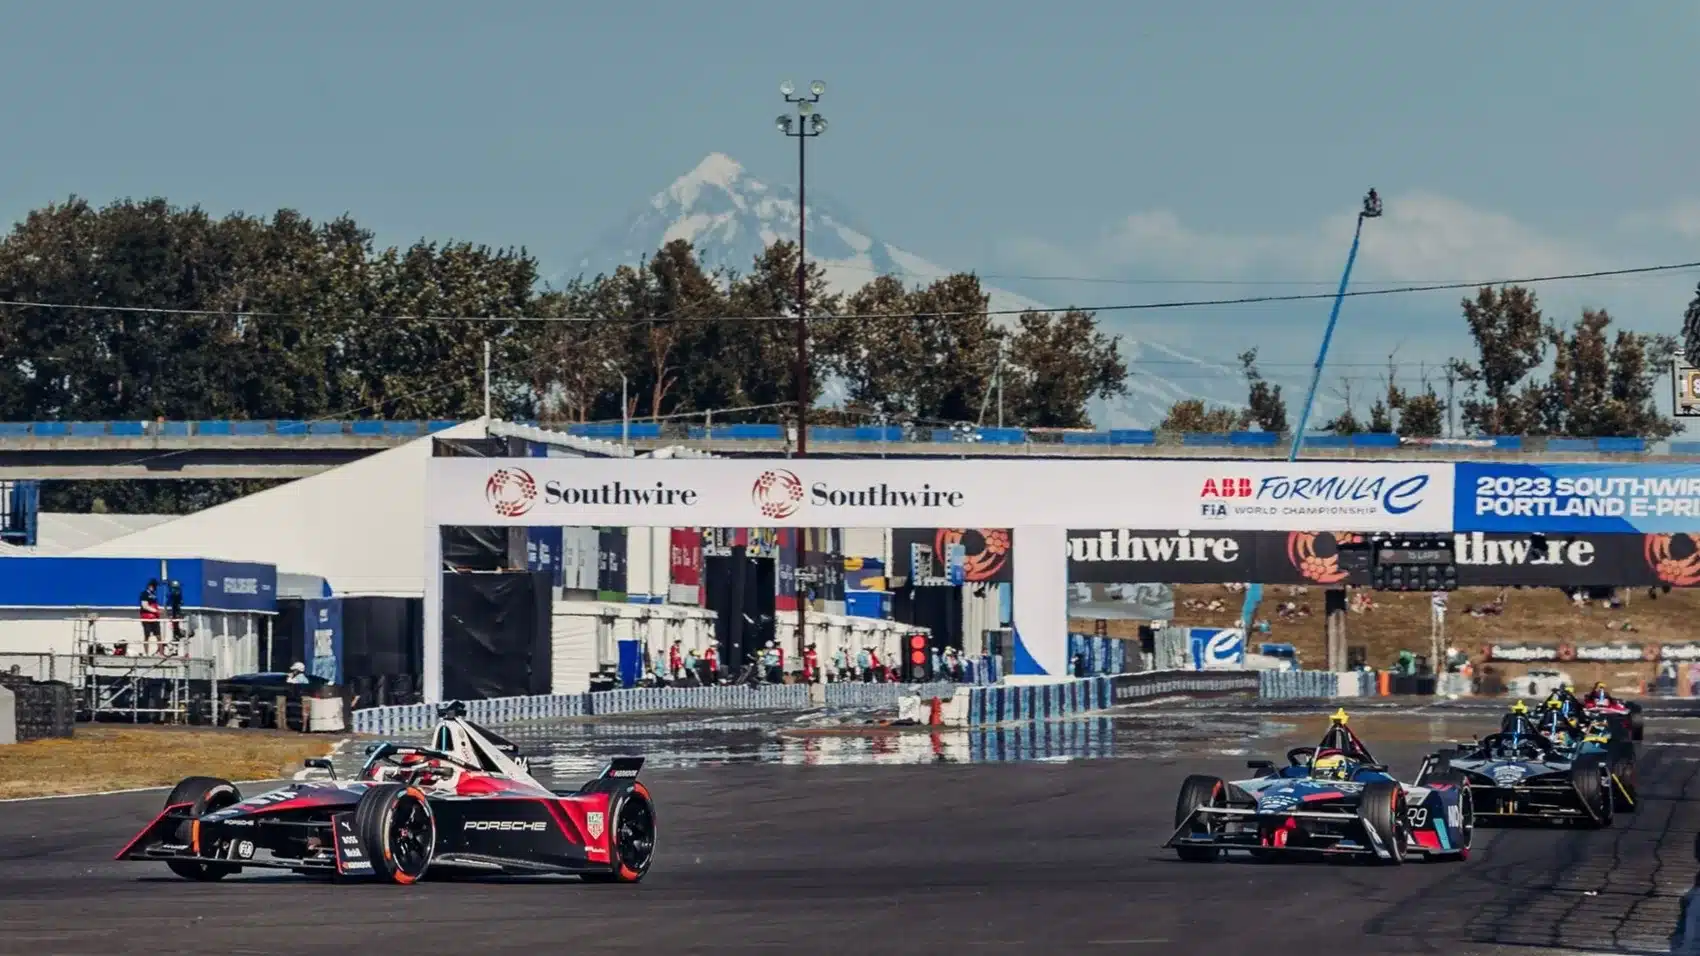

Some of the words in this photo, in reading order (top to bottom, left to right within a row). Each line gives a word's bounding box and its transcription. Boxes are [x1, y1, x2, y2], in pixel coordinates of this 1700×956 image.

[544, 480, 698, 506] Southwire
[811, 481, 964, 508] Southwire
[1200, 478, 1253, 498] ABB
[1256, 475, 1386, 500] FORMULA
[1475, 476, 1551, 497] 2023
[1554, 476, 1700, 497] SOUTHWIR
[1234, 506, 1277, 515] WORLD
[1281, 506, 1377, 515] CHAMPIONSHIP
[1475, 497, 1626, 516] PORTLAND
[1629, 498, 1700, 517] E-PRI
[463, 821, 548, 831] PORSCHE
